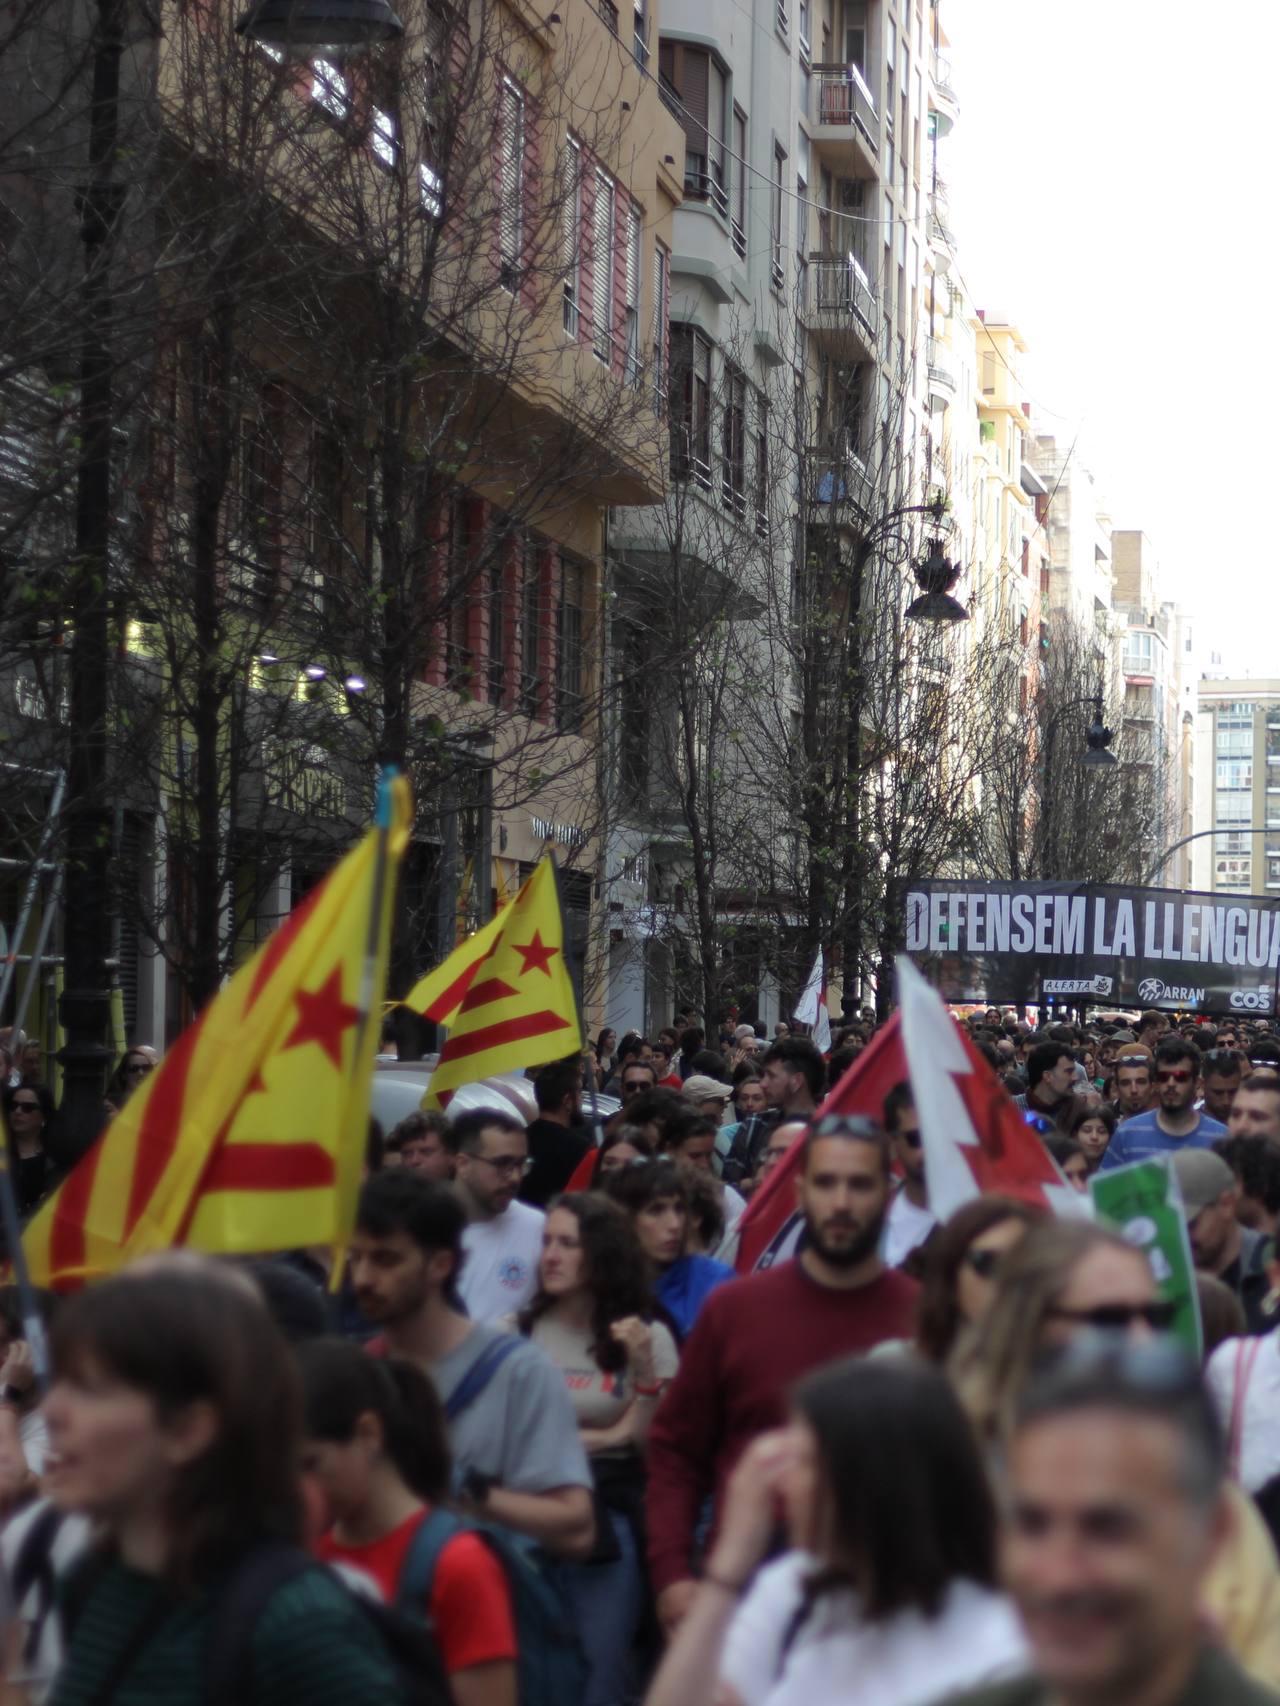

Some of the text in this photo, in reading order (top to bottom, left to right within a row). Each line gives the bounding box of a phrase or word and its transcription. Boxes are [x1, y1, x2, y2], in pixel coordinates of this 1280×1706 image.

[906, 892, 1087, 955] DEFENSEM
[1094, 897, 1135, 957] LA
[1046, 981, 1090, 990] ALERTA
[1164, 986, 1205, 1001] ARRAN
